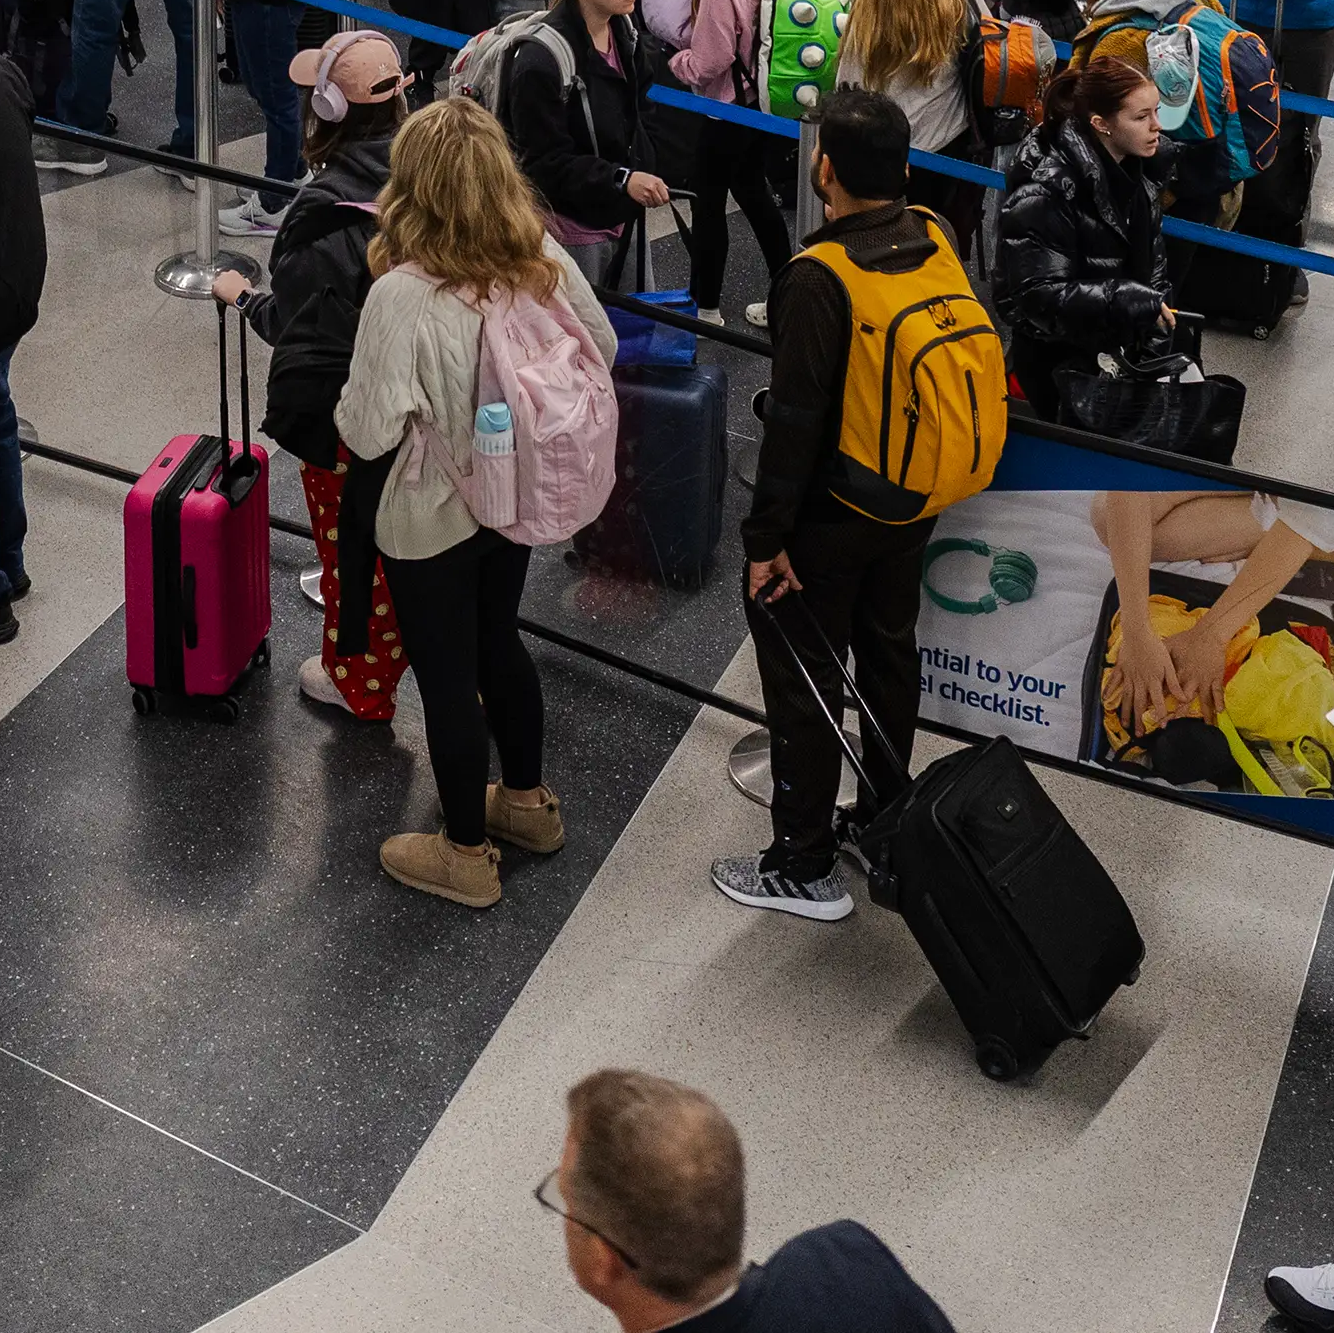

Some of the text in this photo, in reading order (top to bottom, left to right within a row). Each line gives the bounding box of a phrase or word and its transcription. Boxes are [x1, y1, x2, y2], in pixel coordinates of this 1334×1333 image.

[919, 646, 1066, 699] ntial to your
[939, 681, 1050, 727] checklist.
